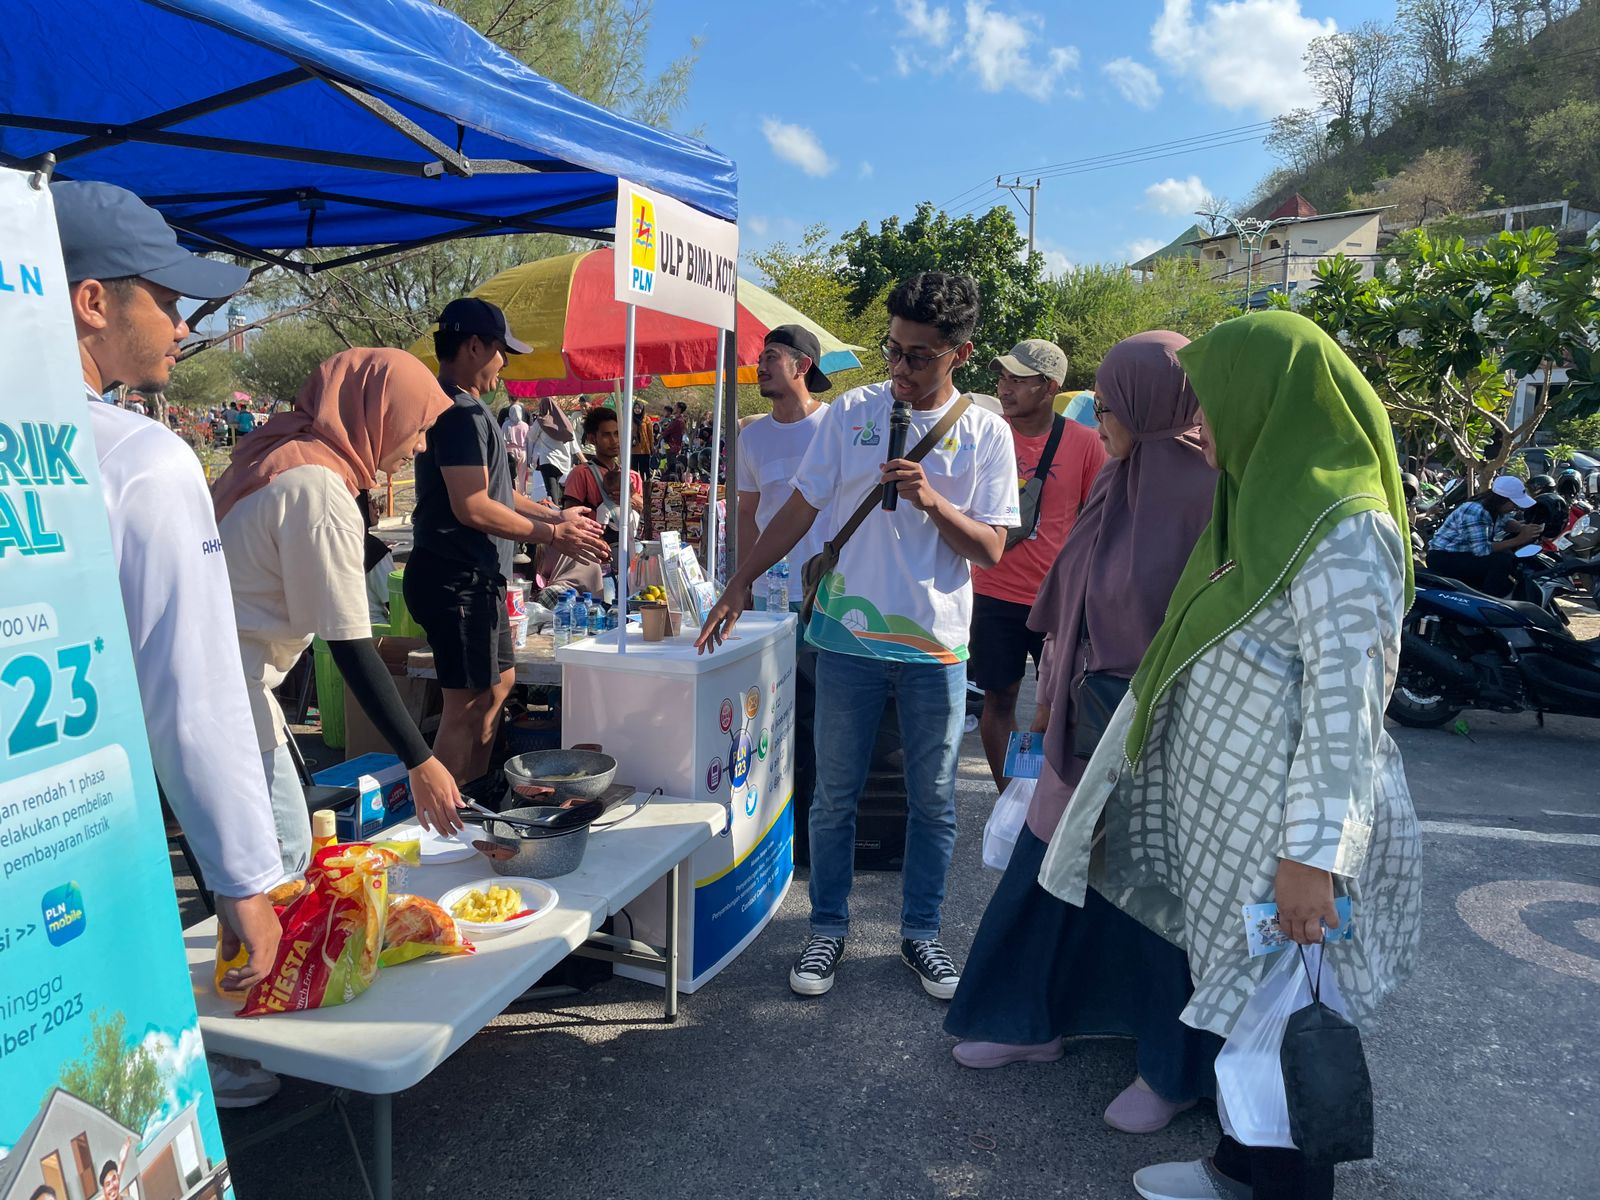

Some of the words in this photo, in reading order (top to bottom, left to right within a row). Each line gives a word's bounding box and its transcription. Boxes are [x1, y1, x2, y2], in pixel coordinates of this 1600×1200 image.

[632, 268, 653, 292] PLN
[660, 231, 684, 277] ULP
[686, 242, 713, 289] BIMA
[715, 254, 736, 298] KOTA
[0, 617, 24, 638] 00
[26, 613, 50, 633] VA
[733, 745, 747, 762] PLN
[735, 760, 747, 778] 123
[0, 803, 20, 825] an
[22, 782, 68, 812] rendah
[69, 779, 76, 793] 1
[79, 769, 106, 795] phasa
[0, 815, 61, 848] elakukan
[62, 791, 114, 828] pembelian
[3, 832, 83, 880] pembayaran
[84, 815, 110, 842] listrik
[45, 902, 67, 921] PLN
[48, 909, 83, 933] mobile
[267, 940, 313, 1012] FIESTA
[0, 1022, 37, 1059] ber
[41, 992, 84, 1035] 2023
